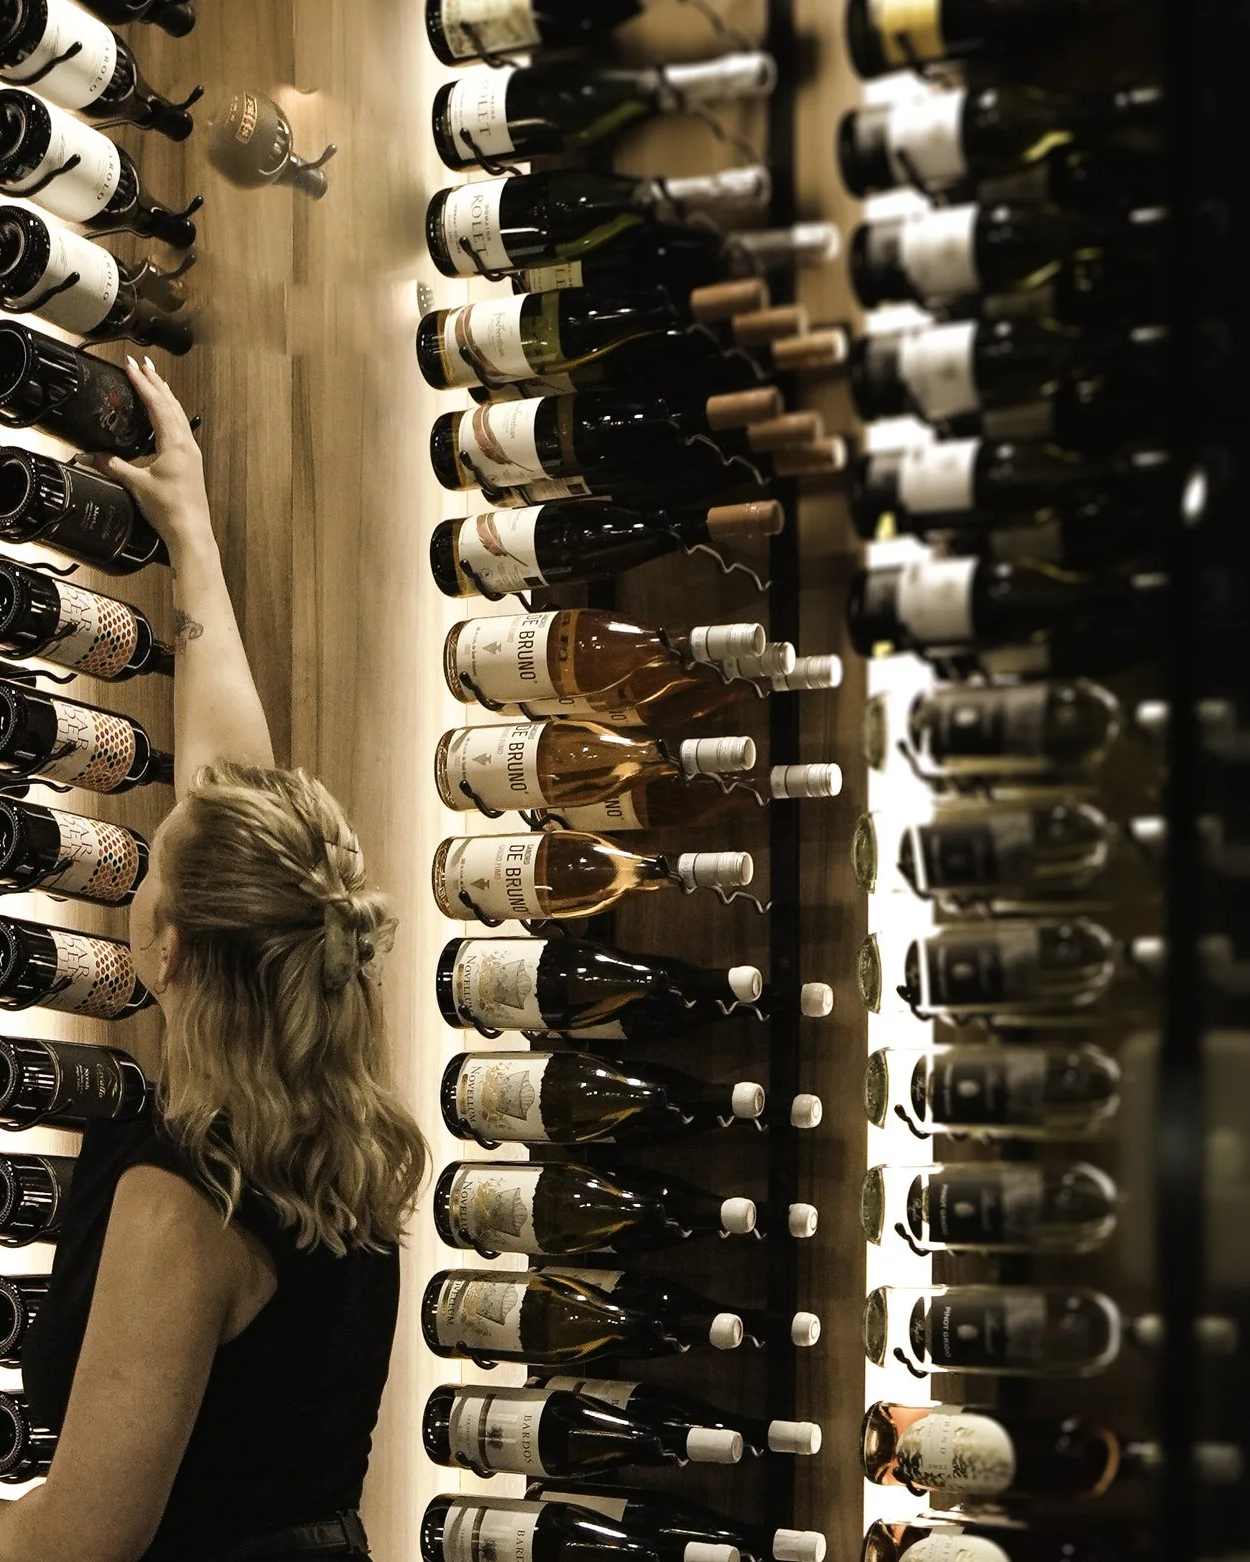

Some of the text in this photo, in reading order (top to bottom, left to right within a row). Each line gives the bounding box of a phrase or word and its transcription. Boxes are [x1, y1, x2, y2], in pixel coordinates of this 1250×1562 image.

[89, 34, 111, 93] AROLO
[477, 80, 491, 136] OLET
[97, 144, 114, 201] AROLO
[471, 194, 490, 257] ROLET
[518, 630, 536, 682] BRUNO
[507, 742, 528, 792] BRUNO
[505, 844, 529, 914] DE BRUNO
[466, 1065, 482, 1123] NOVELLUM
[459, 1181, 474, 1231] NOVELLU
[943, 1306, 952, 1330] PINOT
[521, 1415, 533, 1465] BARDOS
[940, 1420, 951, 1456] RIND
